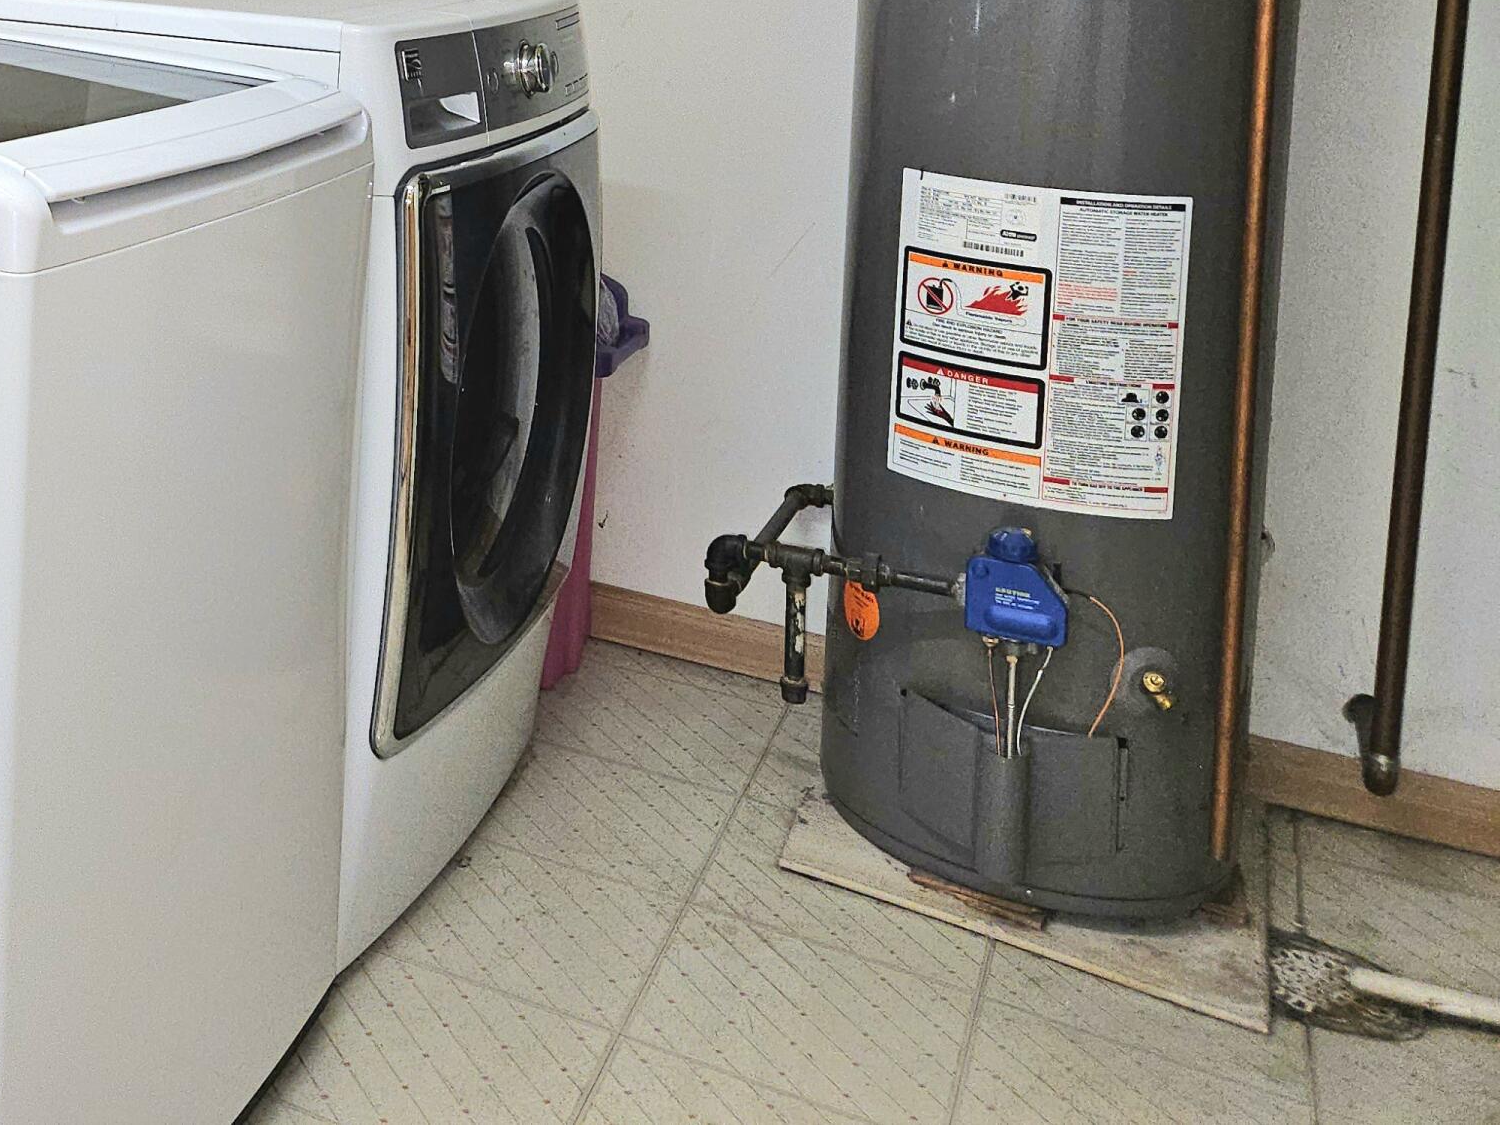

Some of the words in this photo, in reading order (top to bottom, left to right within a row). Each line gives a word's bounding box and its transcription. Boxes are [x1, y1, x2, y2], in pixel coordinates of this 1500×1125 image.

[953, 262, 1003, 277] WARNING
[947, 370, 989, 385] DANGER
[944, 439, 989, 456] WARNING
